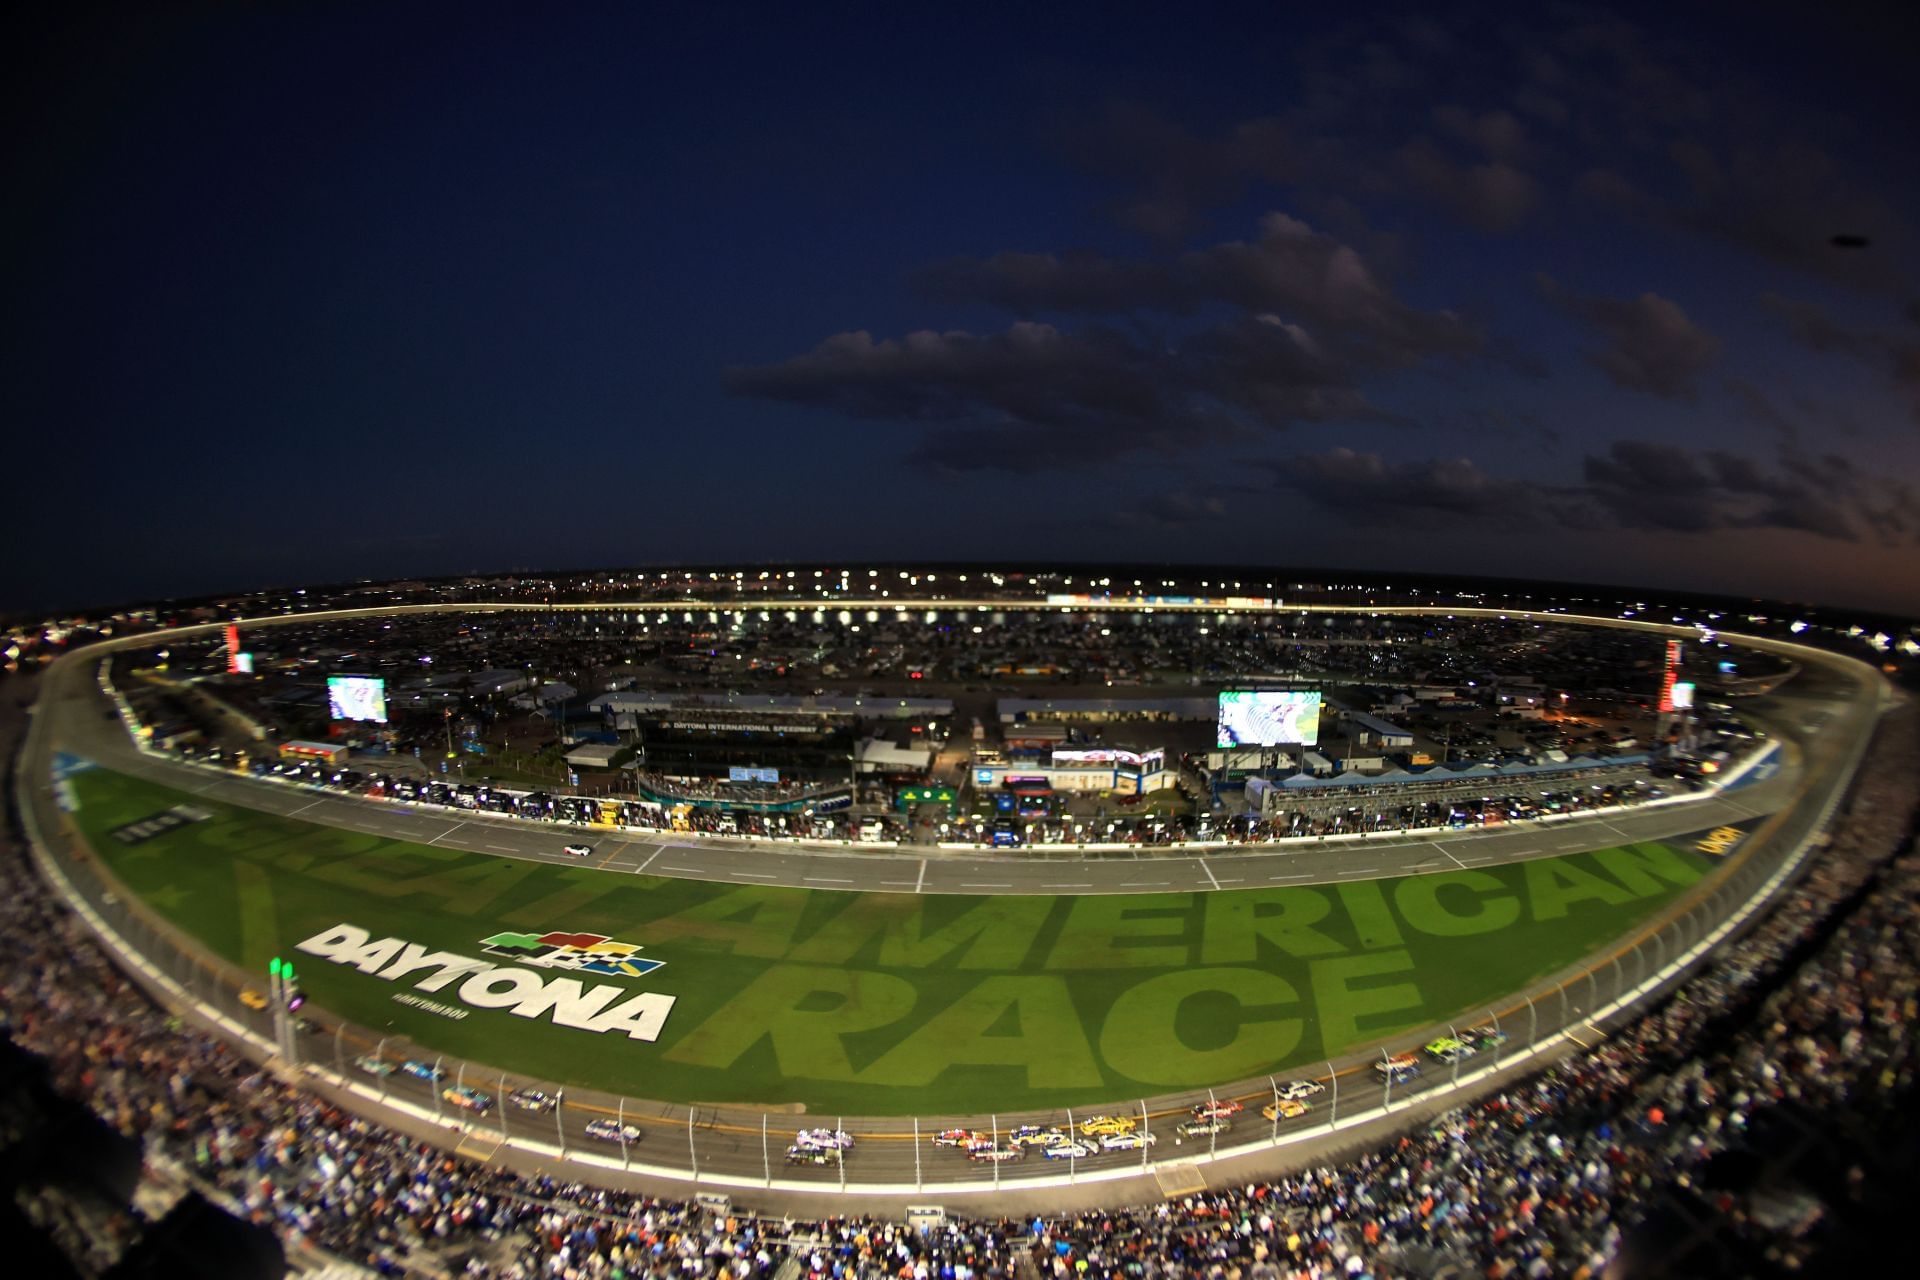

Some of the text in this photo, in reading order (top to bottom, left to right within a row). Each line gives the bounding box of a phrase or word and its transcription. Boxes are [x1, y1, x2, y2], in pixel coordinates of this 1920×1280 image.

[673, 722, 818, 733] DAYTONA INTERNATIONAL SPEEDWAY
[612, 841, 1714, 971] AMERICAN
[295, 923, 678, 1042] DAYTONA
[660, 950, 1425, 1088] RACE
